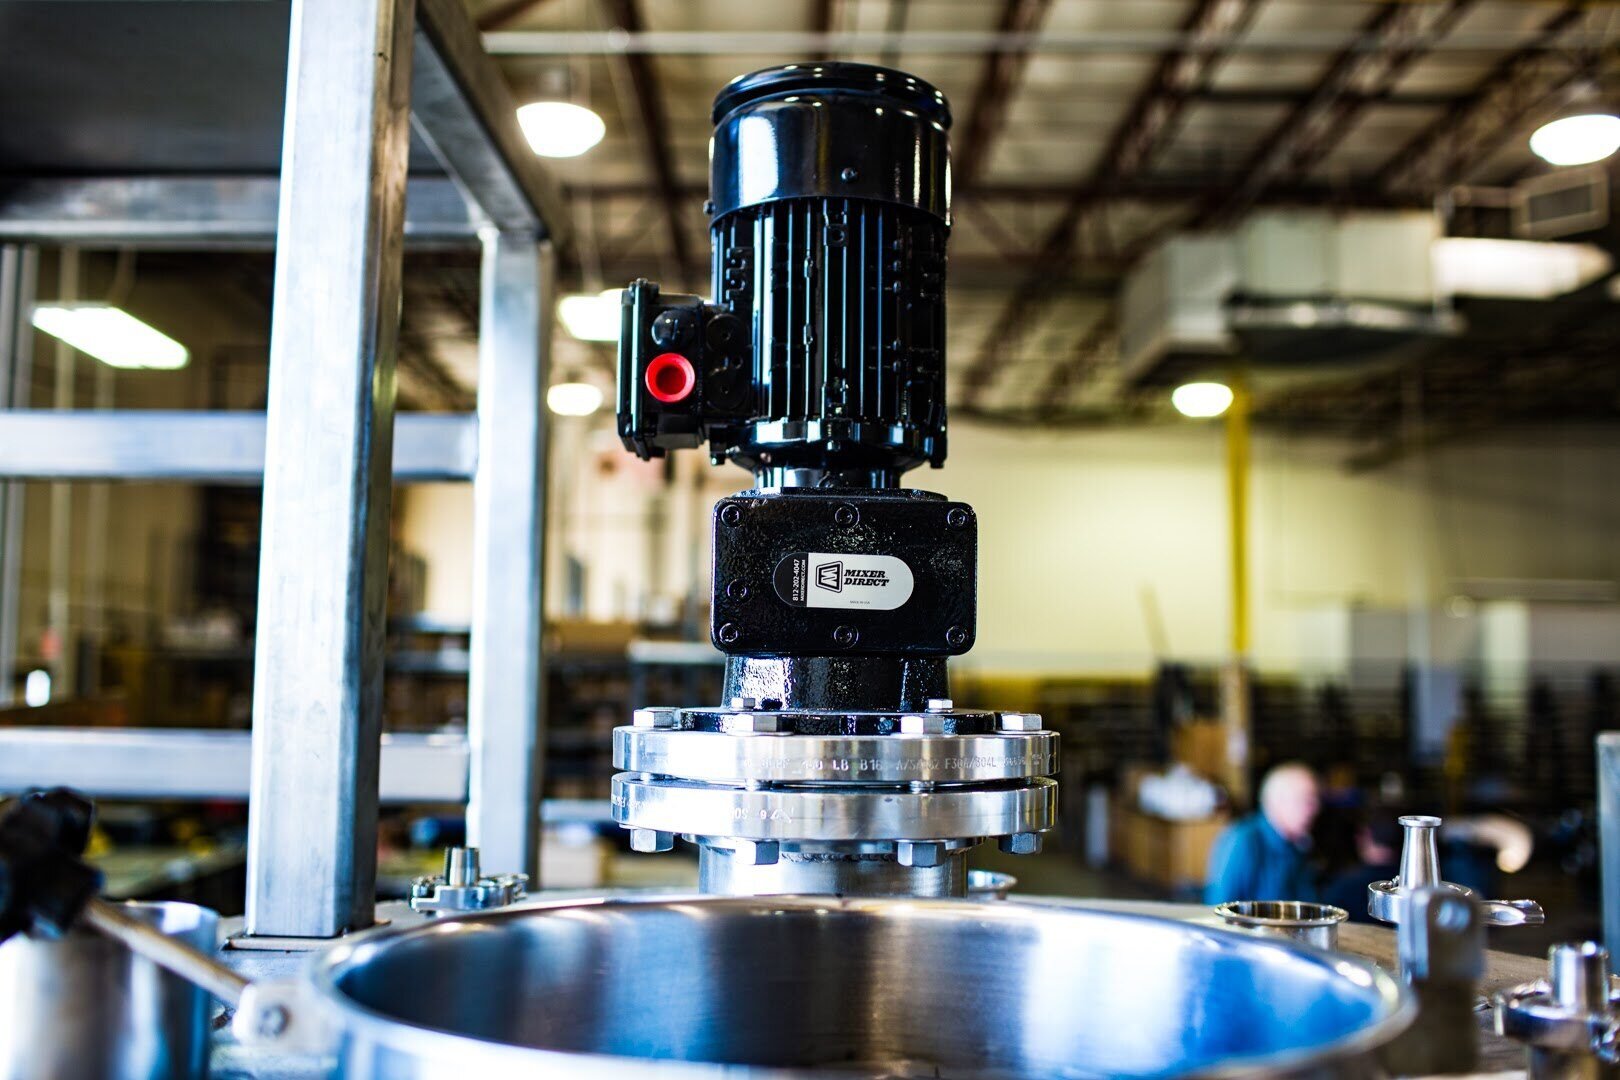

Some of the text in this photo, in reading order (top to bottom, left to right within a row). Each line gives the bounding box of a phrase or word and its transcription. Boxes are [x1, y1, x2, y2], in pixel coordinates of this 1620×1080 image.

[844, 569, 886, 578] MIXER
[792, 559, 800, 602] 812-202-4047
[844, 578, 890, 587] DIRECT
[832, 759, 849, 771] LB
